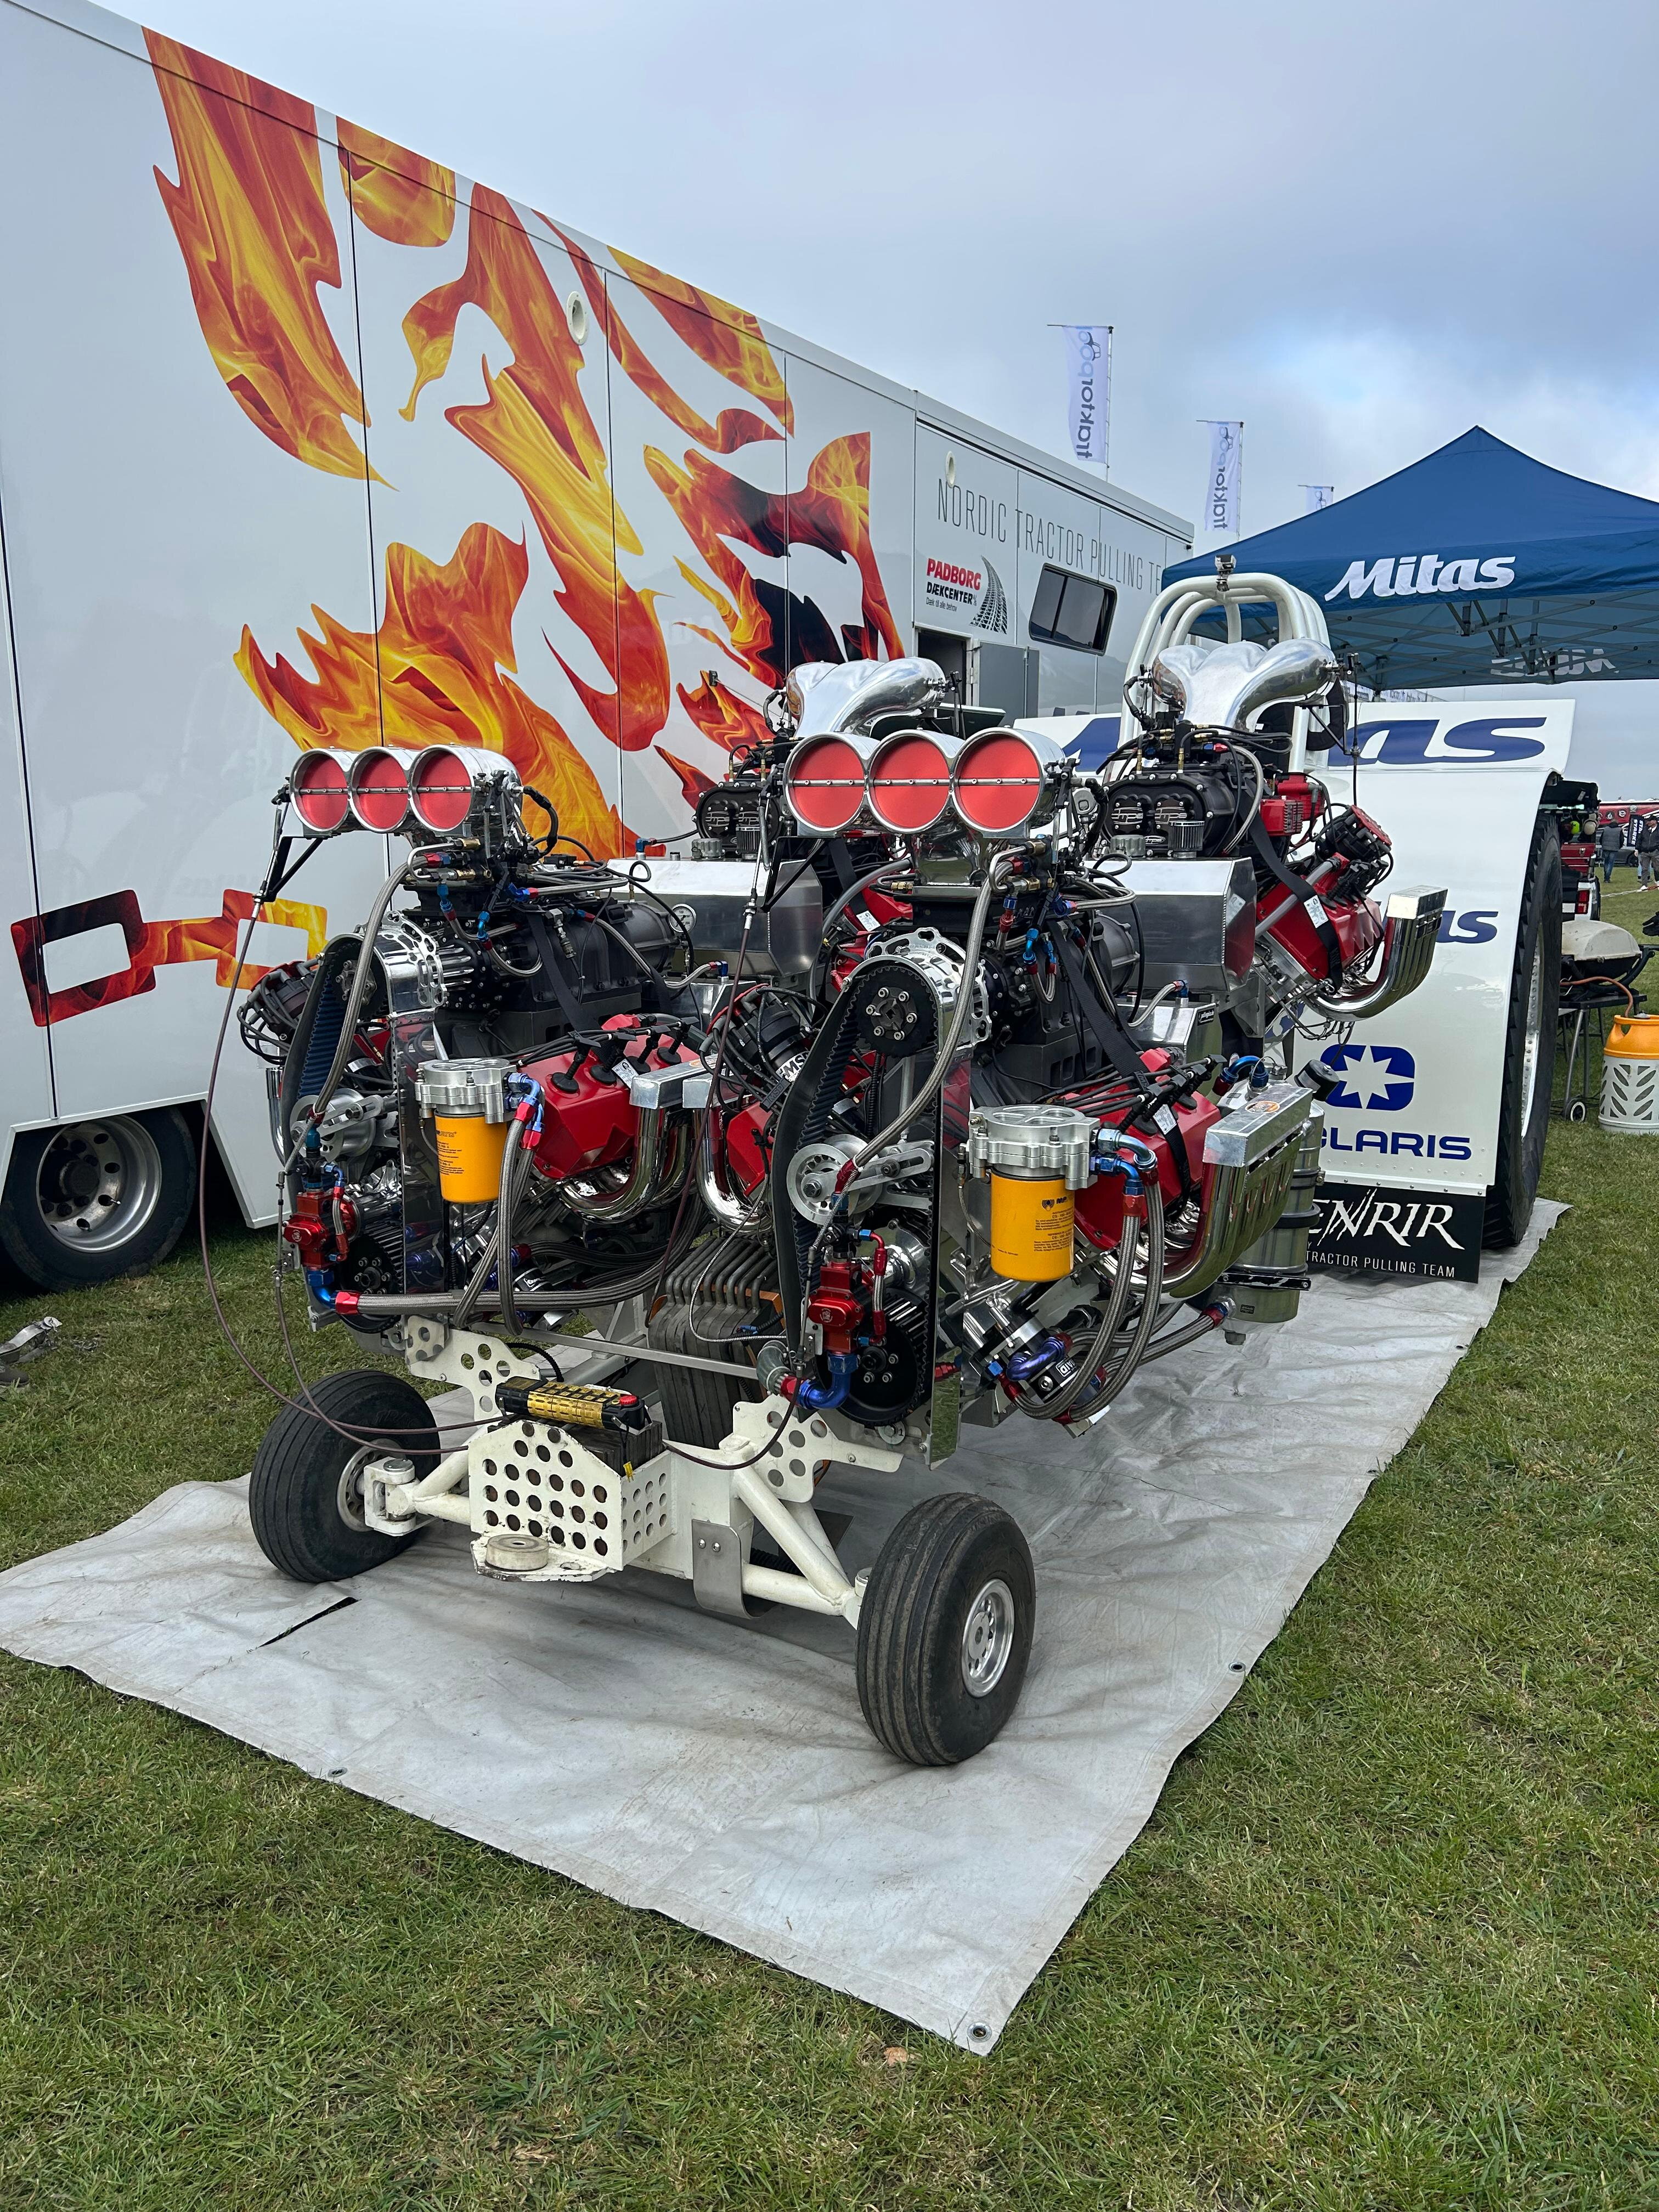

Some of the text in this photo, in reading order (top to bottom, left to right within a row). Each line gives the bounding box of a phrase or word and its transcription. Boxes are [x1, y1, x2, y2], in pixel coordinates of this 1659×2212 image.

[938, 478, 1161, 596] NORDIC TRACTOR PULLING TE
[927, 558, 981, 590] PADBORG
[1324, 554, 1516, 601] Mitas
[927, 582, 973, 605] DÆKCENTER
[1321, 1127, 1472, 1160] LARIS
[1309, 1188, 1465, 1250] ENRIR
[1306, 1250, 1455, 1278] TRACTOR PULLING TEAM
